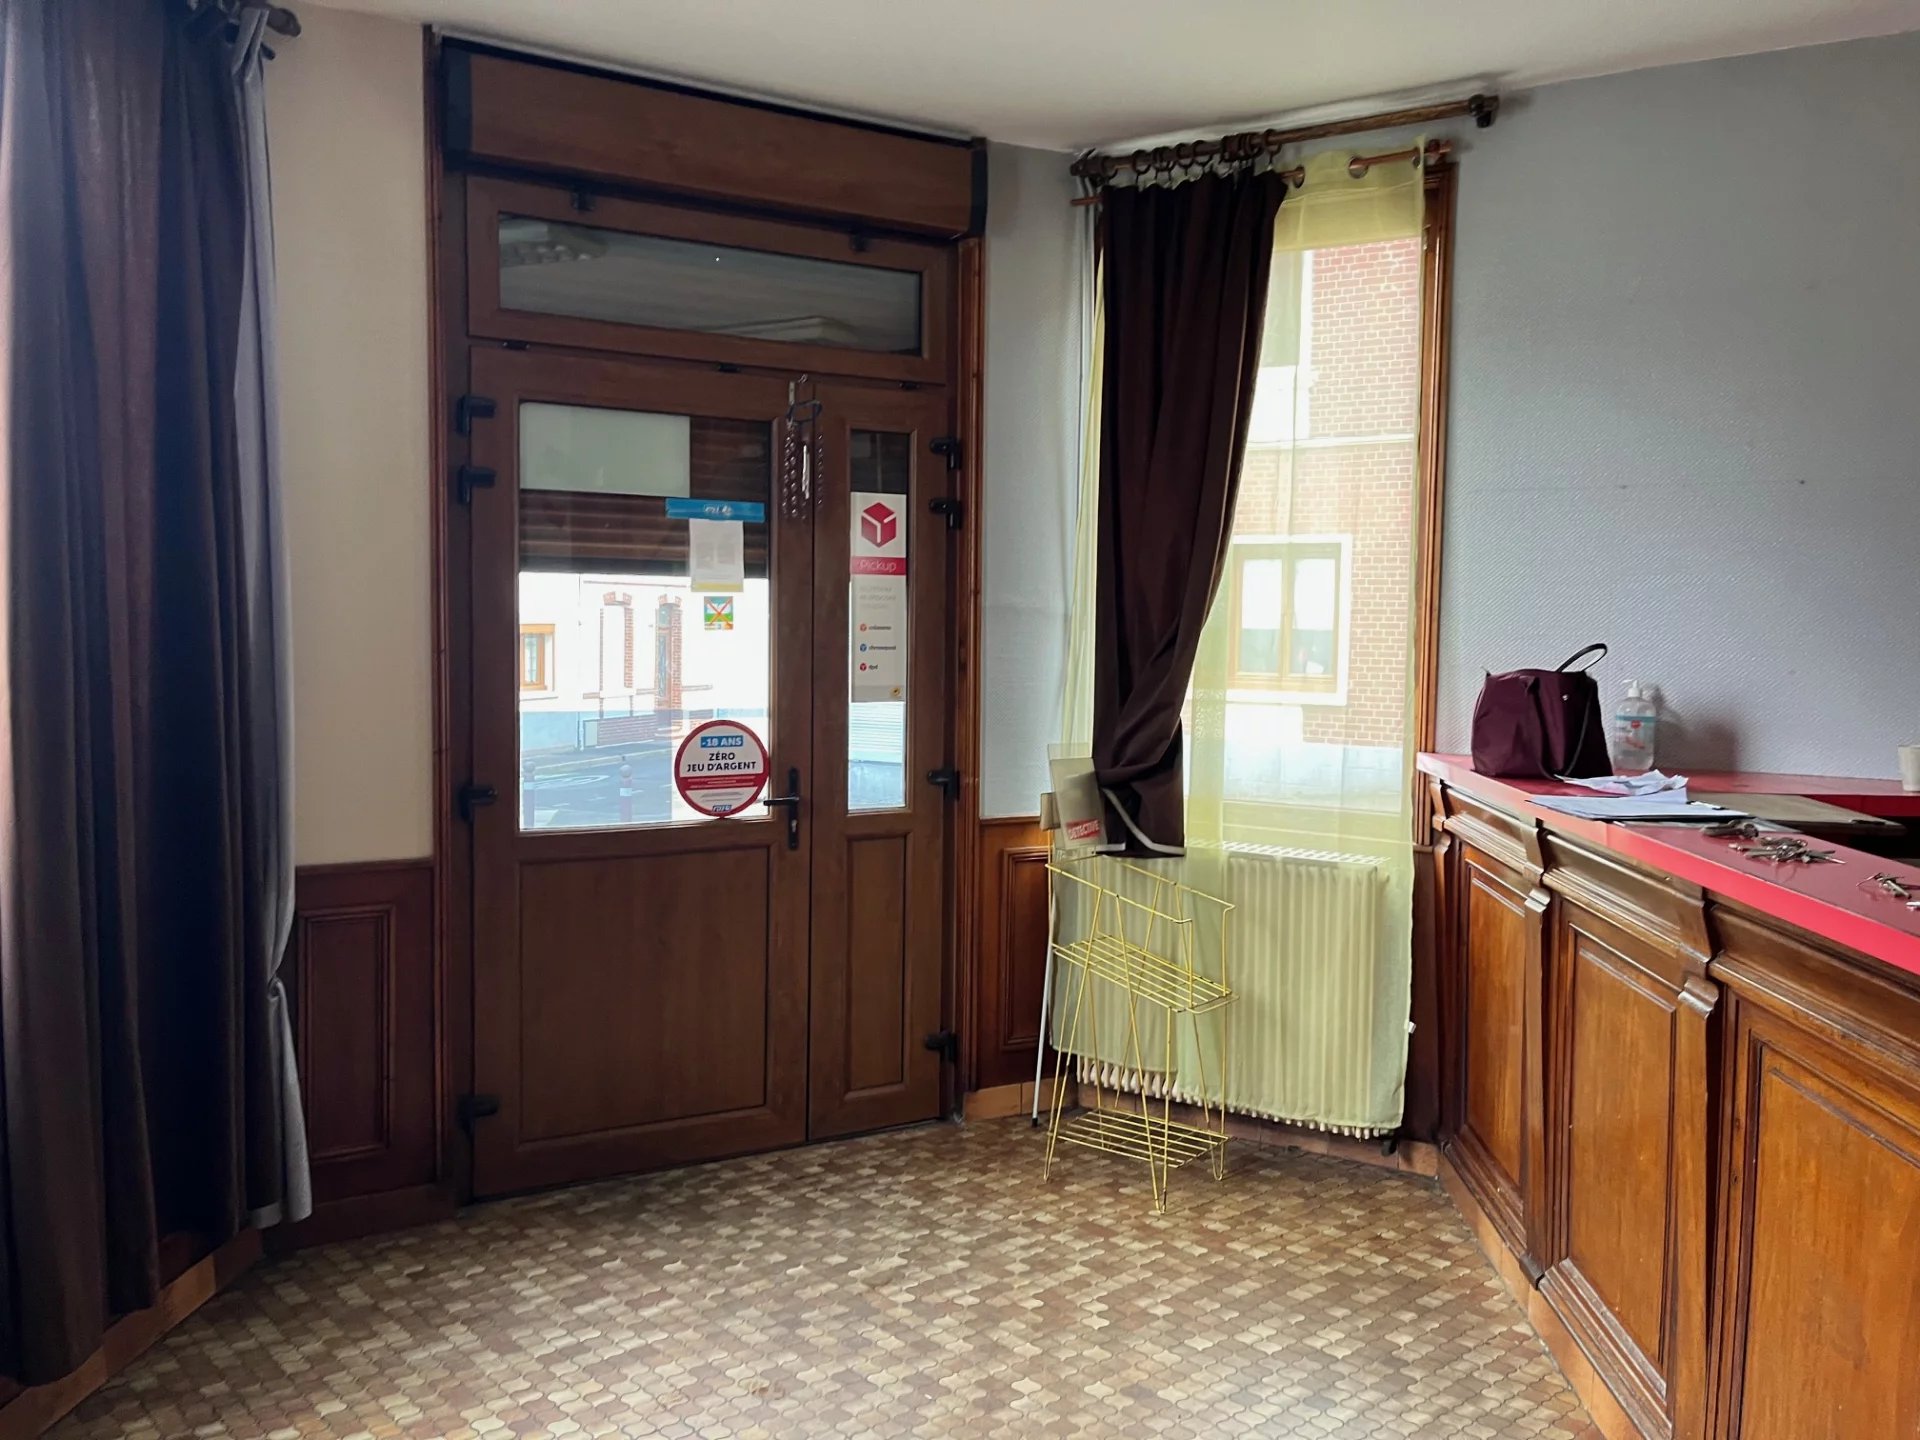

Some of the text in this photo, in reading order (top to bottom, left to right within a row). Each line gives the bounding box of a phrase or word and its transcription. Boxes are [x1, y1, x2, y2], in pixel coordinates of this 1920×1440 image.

[859, 559, 897, 573] Pickup
[702, 737, 742, 747] -18 ANS
[709, 751, 735, 761] ZÉRO
[687, 761, 757, 772] JEU D'ARGENT
